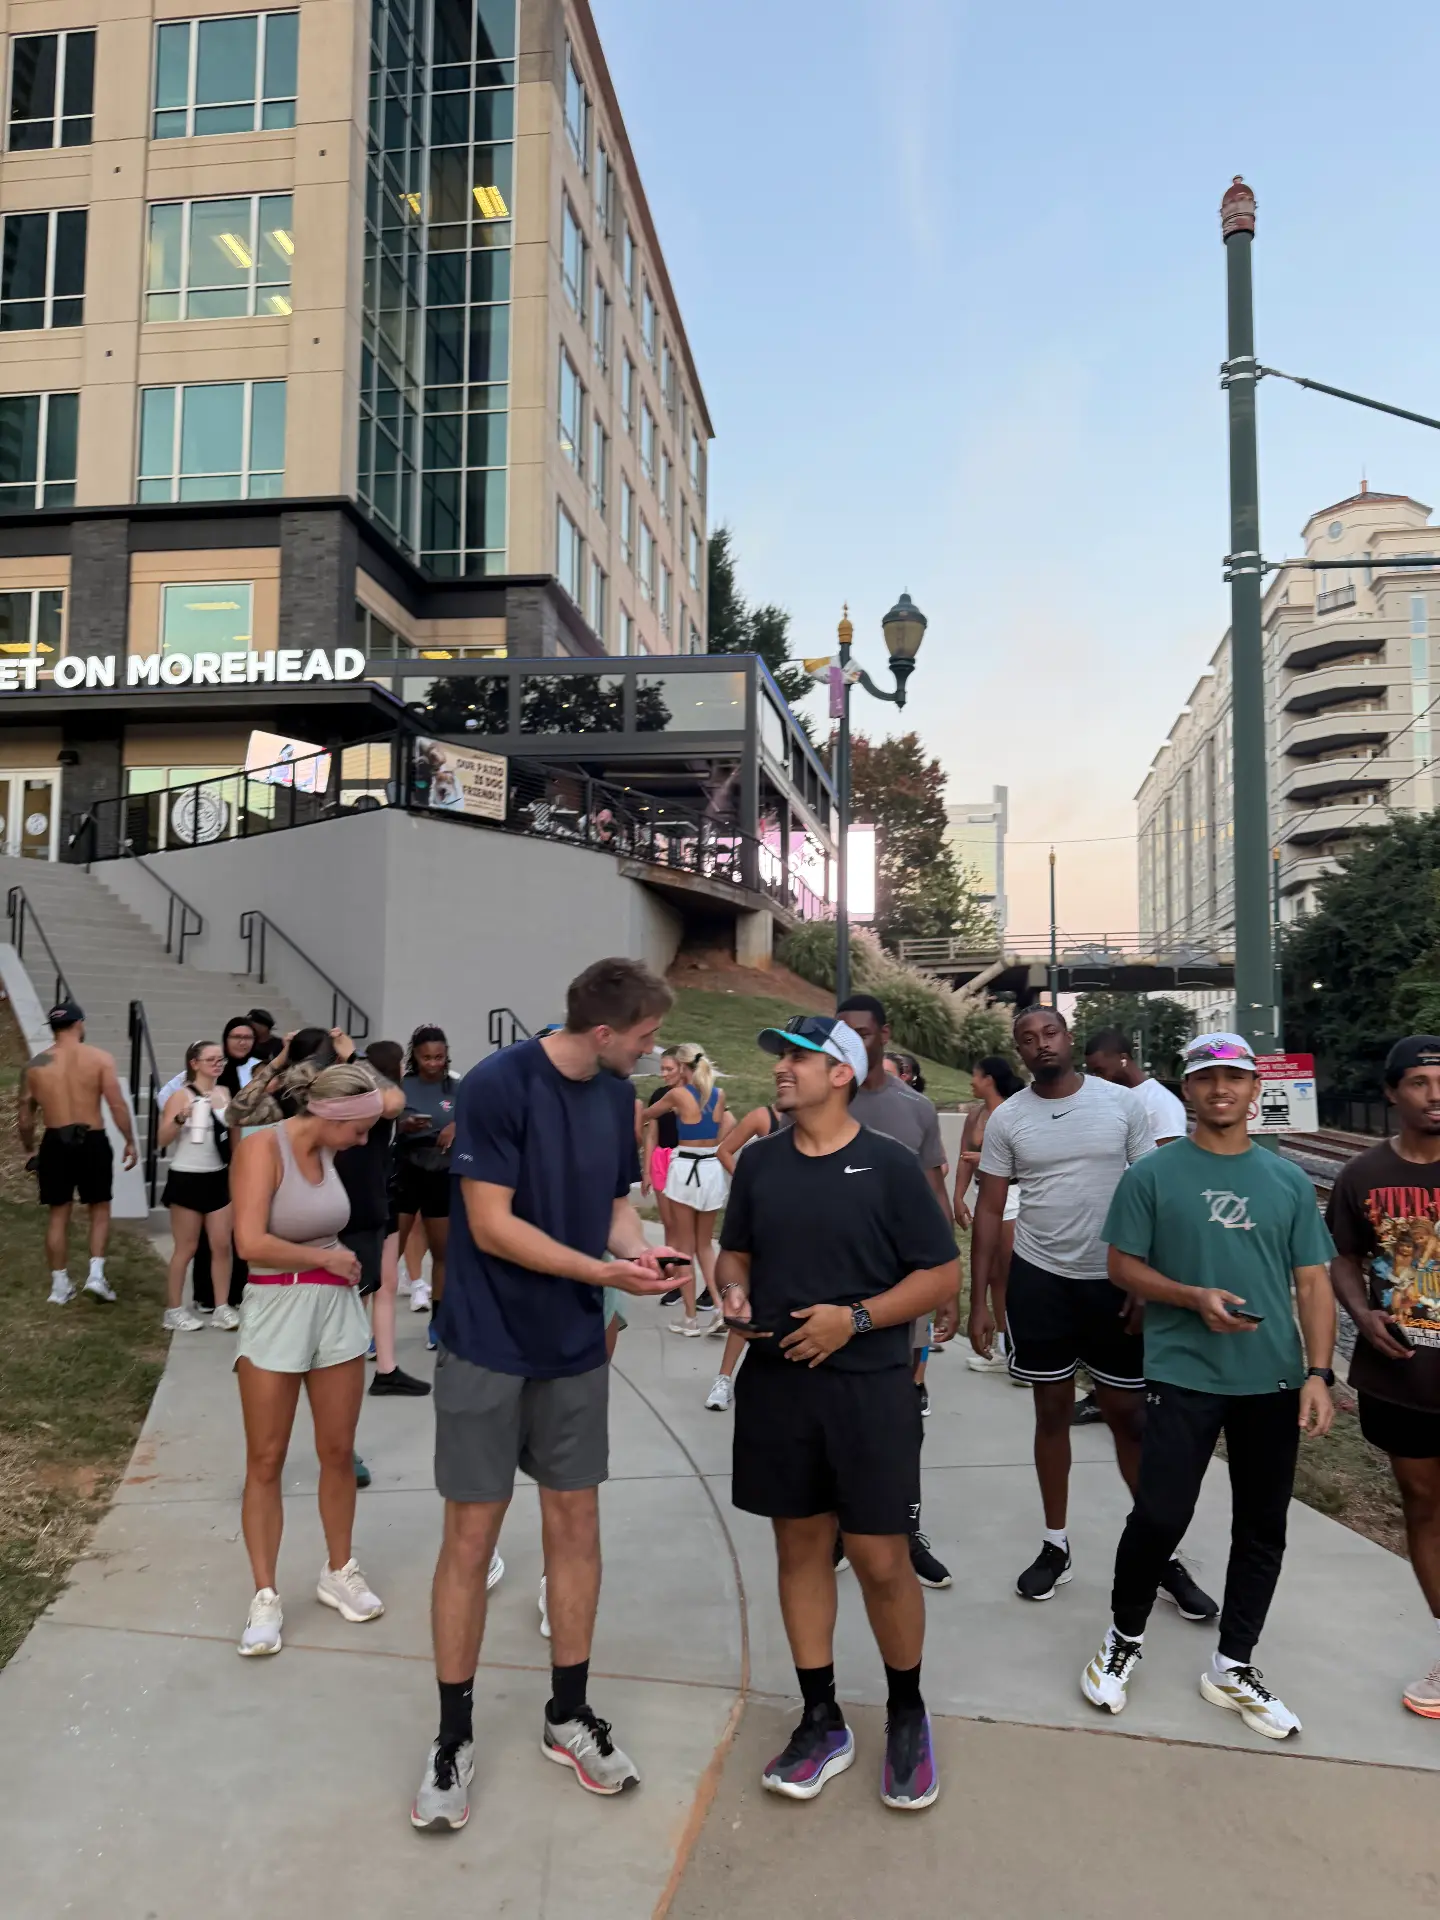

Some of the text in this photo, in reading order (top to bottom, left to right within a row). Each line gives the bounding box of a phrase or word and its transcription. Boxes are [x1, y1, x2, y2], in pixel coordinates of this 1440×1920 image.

[54, 656, 115, 688] ON
[127, 648, 366, 686] MOREHEAD
[476, 763, 504, 778] PATIO
[463, 785, 503, 802] FRIENDLY
